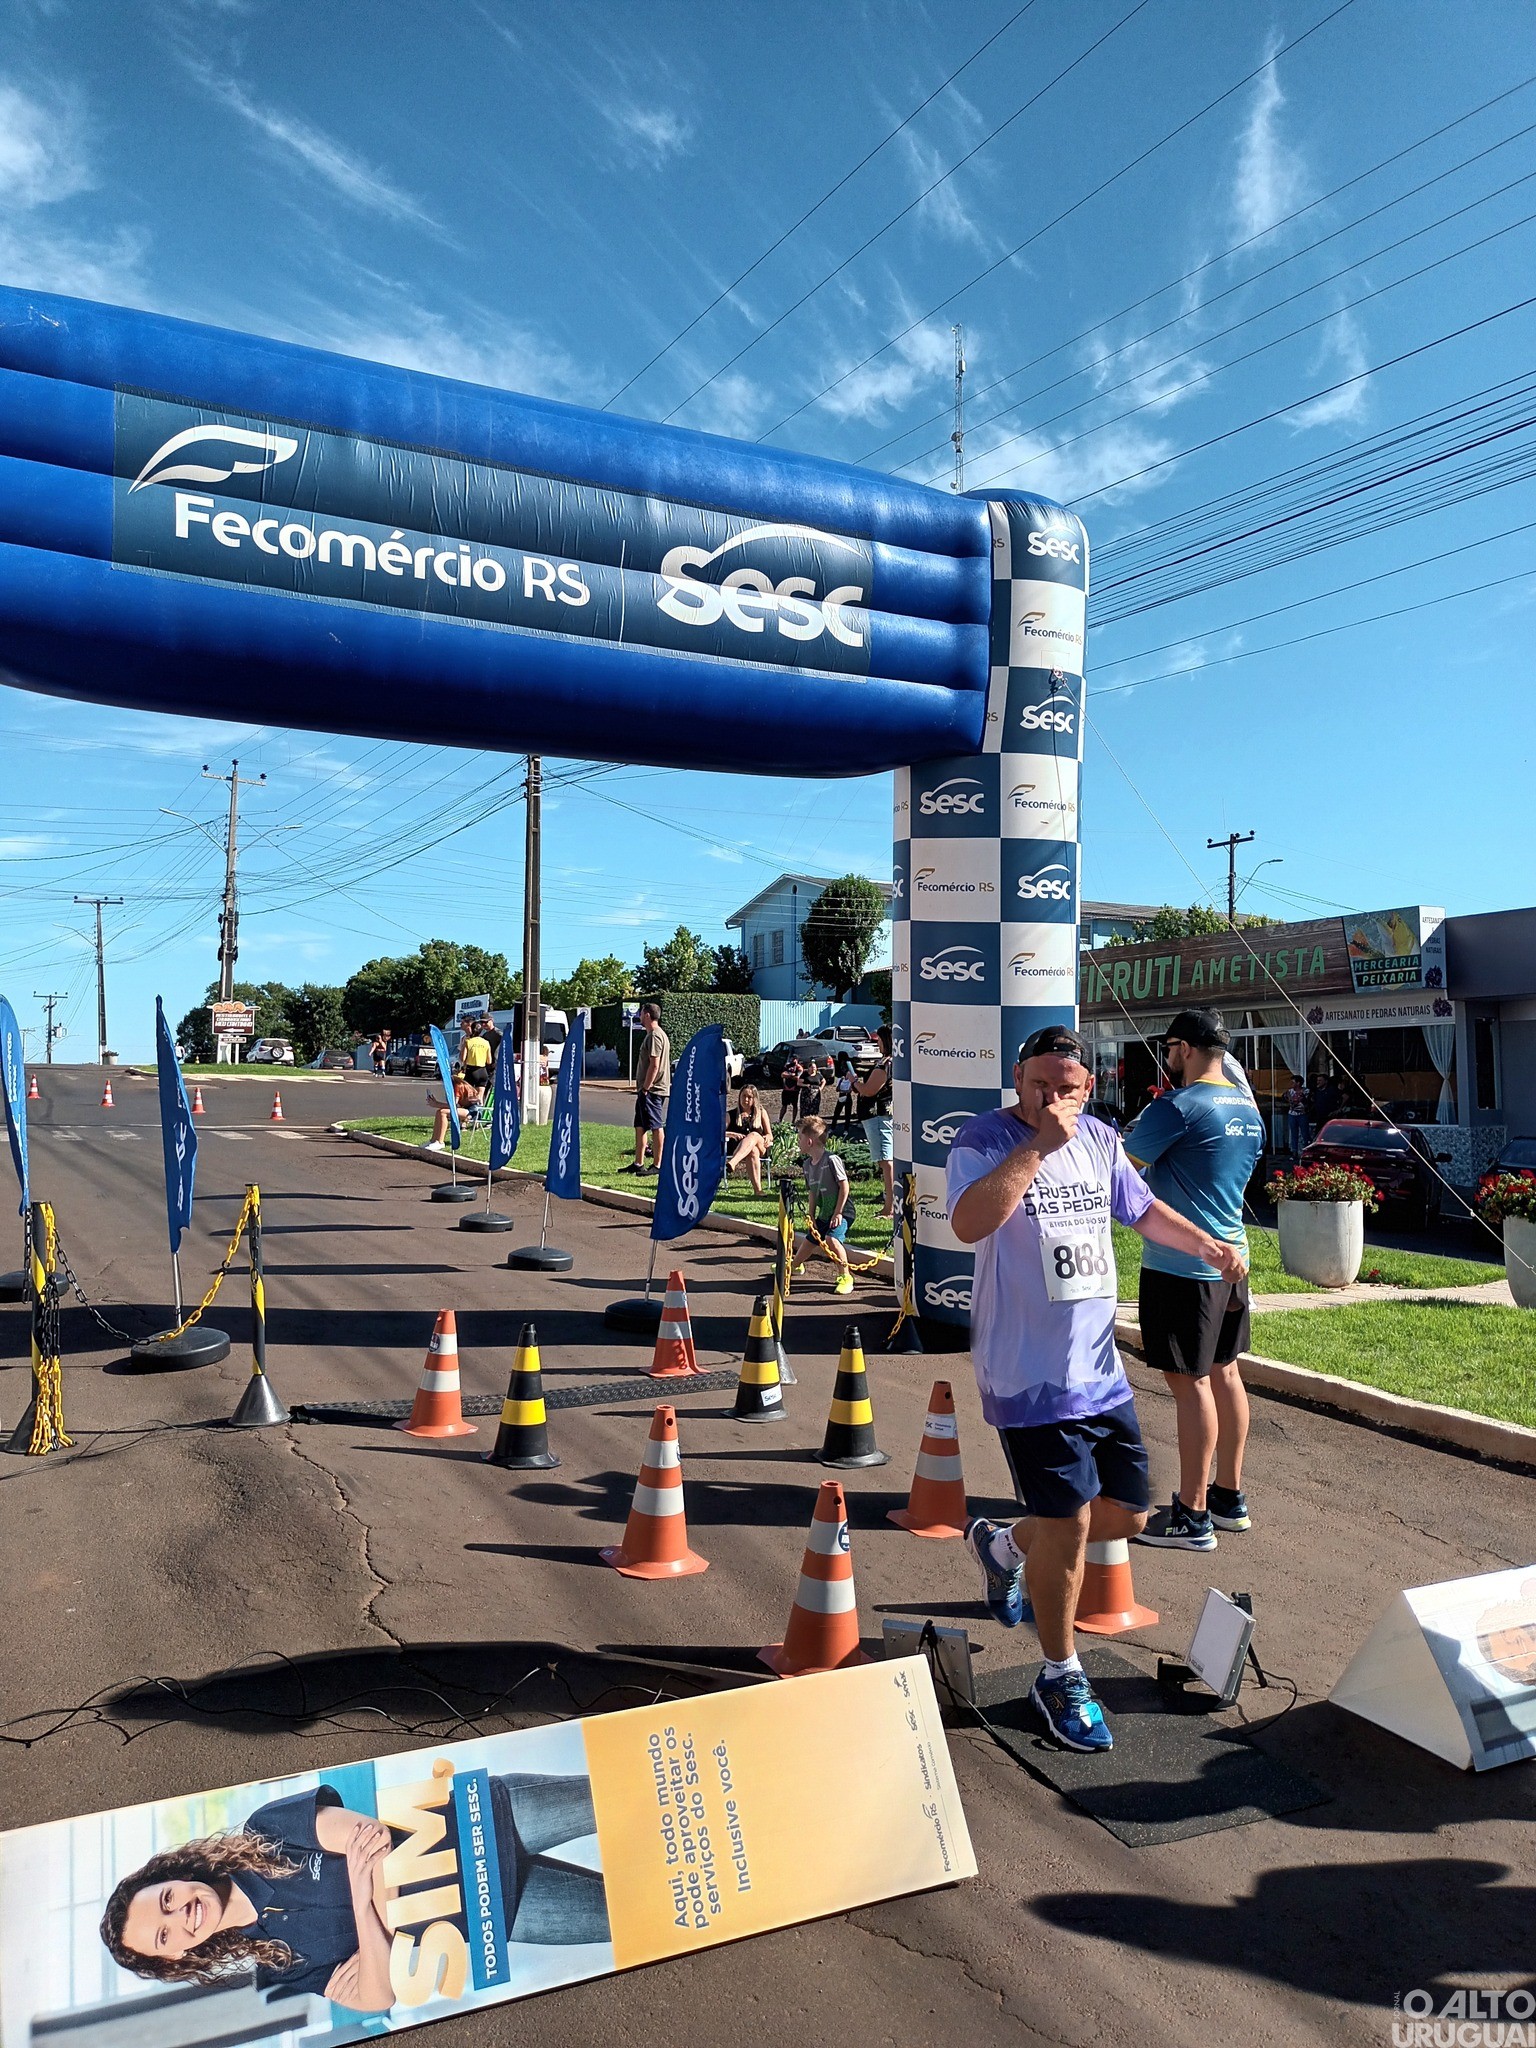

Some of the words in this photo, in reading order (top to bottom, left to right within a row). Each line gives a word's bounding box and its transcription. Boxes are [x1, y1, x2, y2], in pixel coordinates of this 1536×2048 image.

[174, 493, 506, 592] Fecomércio
[524, 556, 590, 608] RS
[1027, 522, 1080, 565] Sesc
[656, 524, 865, 647] Sesc
[1024, 626, 1074, 643] Fecomércio
[1075, 634, 1082, 645] RS
[1020, 696, 1075, 734] Sesc
[920, 778, 984, 814] Sesc
[1014, 799, 1067, 811] Fecomércio
[917, 882, 976, 892] Fecomércio
[979, 882, 995, 892] RS
[1017, 864, 1071, 900] Sesc
[920, 945, 985, 981] Sesc
[1014, 966, 1066, 977] Fecomércio
[1191, 945, 1326, 987] AMETISTA
[1354, 956, 1420, 972] MERCEARIA
[1362, 971, 1417, 985] PEIXARIA
[1325, 1010, 1365, 1021] ARTESANATO
[1366, 1009, 1370, 1019] E
[1371, 1008, 1397, 1019] PEDRAS
[1398, 1005, 1431, 1017] NATURAIS
[918, 1046, 976, 1059] Fecomércio
[980, 1049, 995, 1059] RS
[685, 1045, 698, 1123] Fecomércio
[672, 1134, 703, 1221] Sesc
[1025, 1201, 1060, 1217] DAS
[924, 1275, 973, 1310] Ses
[1165, 1525, 1189, 1536] FILA
[664, 1726, 677, 1750] os
[647, 1733, 670, 1806] mundo
[682, 1732, 699, 1786] Sesc.
[713, 1739, 734, 1794] você.
[917, 1743, 932, 1791] Sindicatos
[466, 1778, 483, 1823] SESC.
[668, 1757, 697, 1864] aproveitar
[691, 1792, 705, 1820] do
[929, 1803, 938, 1817] RS
[472, 1825, 486, 1857] SER
[660, 1813, 679, 1865] todo
[726, 1800, 751, 1893] Inclusive
[934, 1818, 952, 1873] Fecomércio
[309, 1852, 323, 1881] Sesc
[697, 1826, 721, 1915] serviços
[475, 1858, 491, 1918] PODEM
[668, 1870, 690, 1928] Aqui,
[686, 1871, 710, 1929] pode
[481, 1919, 498, 1980] TODOS
